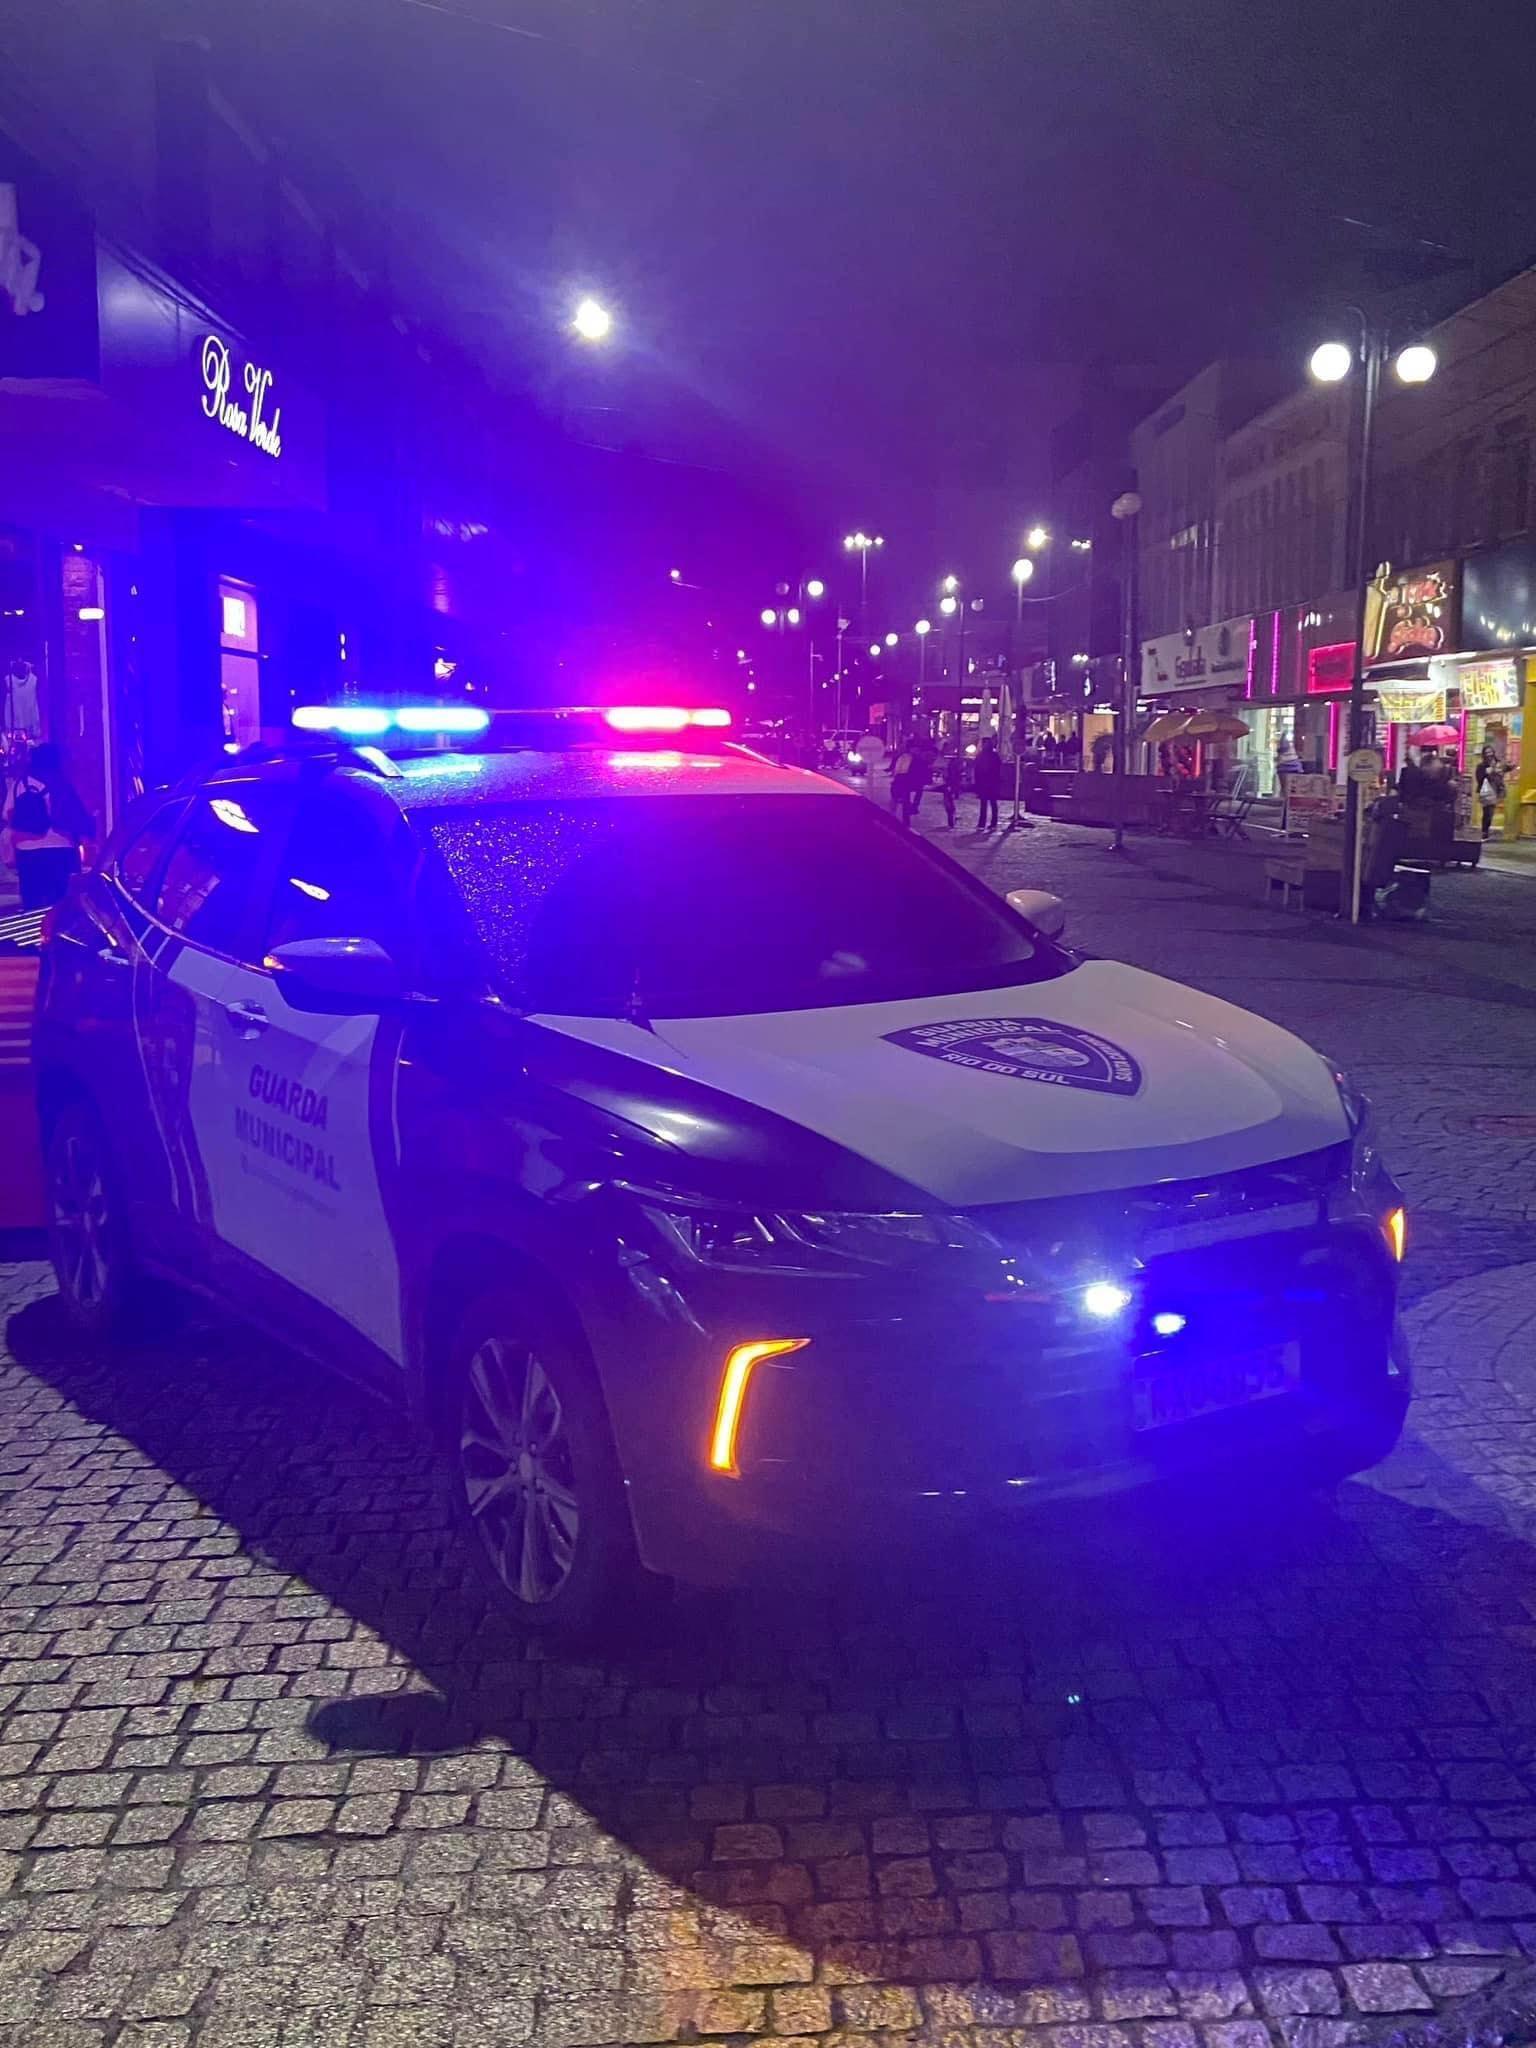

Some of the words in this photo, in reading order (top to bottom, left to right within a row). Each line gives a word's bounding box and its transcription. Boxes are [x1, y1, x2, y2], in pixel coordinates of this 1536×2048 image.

[201, 335, 248, 437] Rosa
[244, 362, 281, 457] Verde
[911, 1019, 1021, 1038] GUARDA
[917, 1023, 1062, 1048] MUNICIPAL
[942, 1052, 978, 1067] RIO
[985, 1062, 1019, 1074] DO
[1022, 1068, 1072, 1085] SUL
[248, 1062, 329, 1131] GUARDA
[235, 1104, 342, 1192] MUNICIPAL
